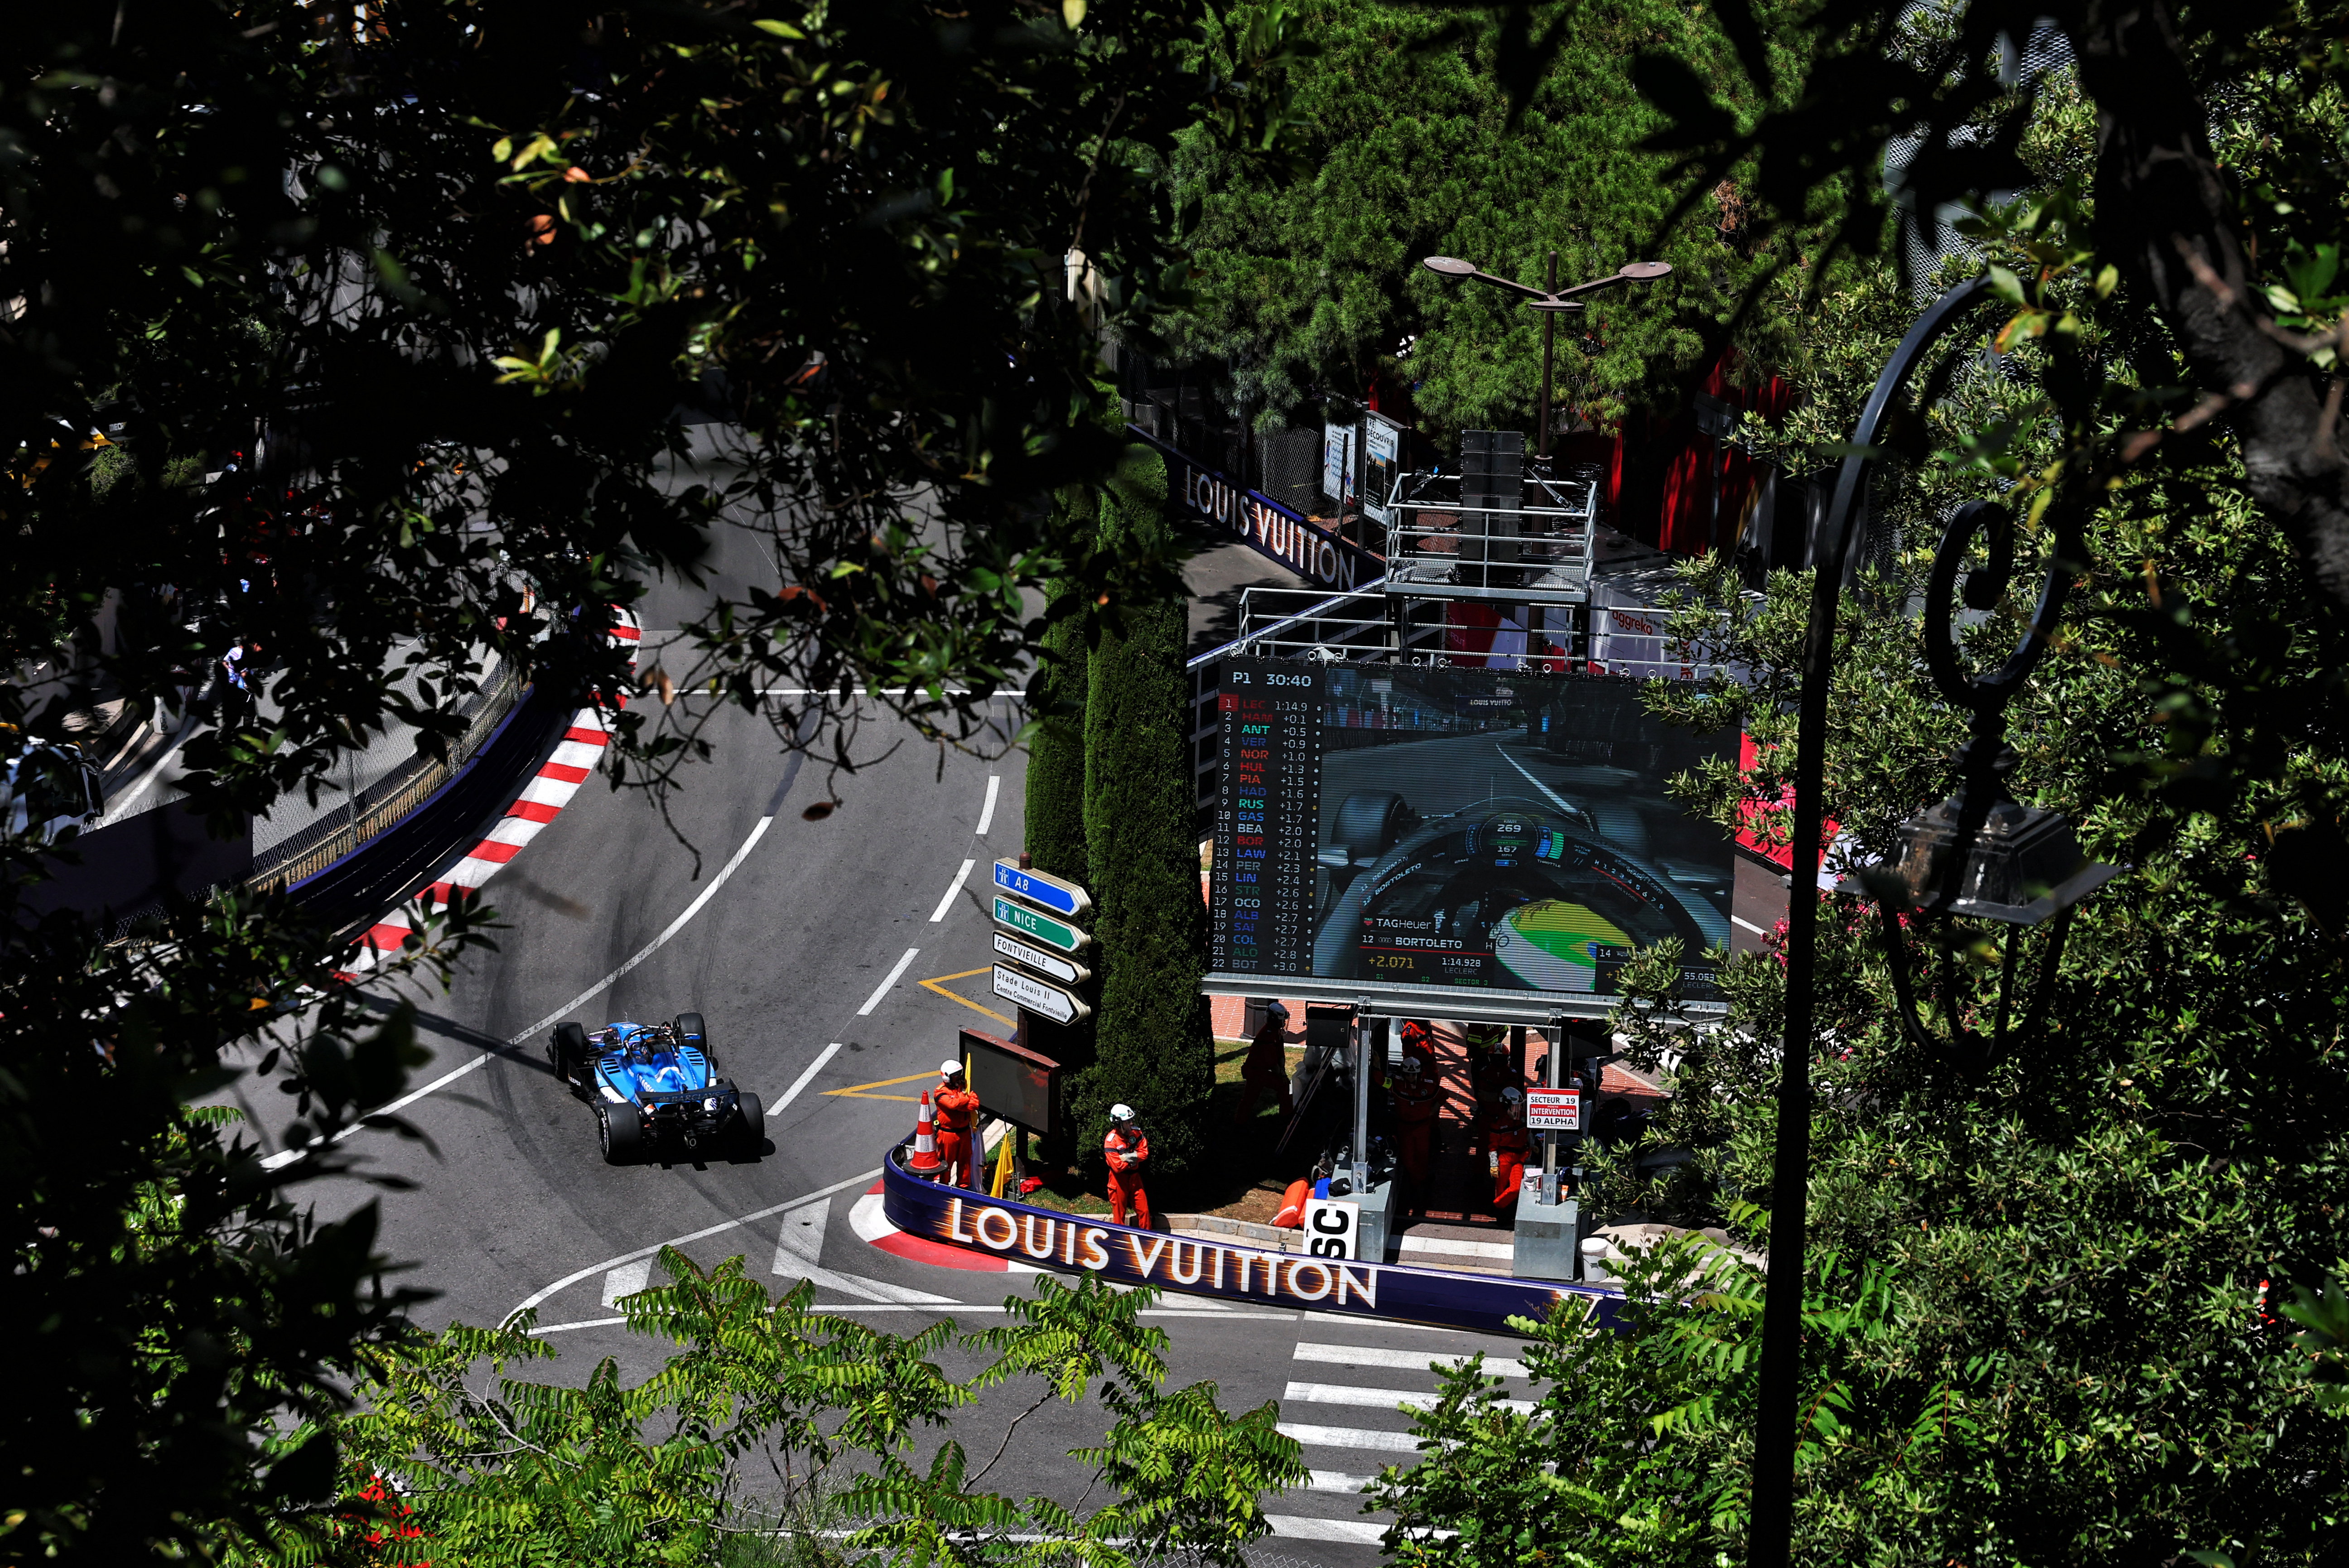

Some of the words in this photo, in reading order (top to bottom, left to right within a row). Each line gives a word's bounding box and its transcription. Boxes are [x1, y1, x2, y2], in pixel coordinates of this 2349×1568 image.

[1367, 428, 1394, 448] DÉCOUVRIR
[1187, 464, 1249, 536] LOUIS
[1256, 502, 1355, 591] VUITTON
[1612, 611, 1653, 635] aggreko
[1233, 672, 1251, 684] P1
[1267, 674, 1312, 687] 30:40
[1243, 700, 1265, 709] LEC
[1276, 701, 1307, 711] 1:14.9
[1243, 713, 1272, 722] HAM
[1284, 715, 1306, 724] +0.1
[1242, 725, 1270, 734] ANT
[1283, 728, 1306, 736] +0.5
[1242, 737, 1266, 746] VER
[1283, 740, 1305, 748] +0.9
[1224, 749, 1230, 757] 5
[1241, 749, 1269, 759] NOR
[1283, 752, 1305, 761] +1.0
[1240, 762, 1265, 772] HUL
[1282, 765, 1304, 773] +1.3
[1240, 774, 1260, 783] PIA
[1281, 777, 1303, 786] +1.5
[1222, 786, 1228, 794] 8
[1240, 786, 1266, 796] HAD
[1281, 789, 1303, 798] +1.6
[1239, 799, 1264, 808] RUS
[1280, 801, 1302, 811] +1.7
[1219, 811, 1230, 819] 10
[1239, 812, 1264, 821] GAS
[1280, 814, 1302, 823] +1.7
[1218, 823, 1229, 831] 11
[1238, 824, 1263, 833] BEA
[1279, 826, 1302, 835] +2.0
[1497, 824, 1521, 833] 269
[1238, 836, 1263, 845] BOR
[1279, 839, 1301, 848] +2.0
[1217, 848, 1229, 856] 13
[1237, 849, 1266, 858] LAW
[1278, 851, 1300, 860] +2.1
[1216, 860, 1228, 868] 14
[1236, 861, 1260, 870] PER
[1278, 864, 1299, 873] +2.3
[1373, 856, 1409, 882] BEARMAN
[1537, 859, 1561, 868] THROTTLE
[1015, 876, 1029, 891] A8
[1216, 873, 1227, 881] 15
[1236, 873, 1256, 882] LIN
[1277, 876, 1299, 884] +2.4
[1363, 896, 1372, 906] 12
[1375, 863, 1422, 896] BORTOLETO
[1215, 885, 1227, 893] 16
[1235, 886, 1260, 895] STR
[1277, 888, 1299, 897] +2.6
[1235, 898, 1260, 907] OCO
[1276, 901, 1298, 910] +2.6
[1014, 911, 1037, 931] NICE
[1215, 909, 1226, 918] 18
[1234, 911, 1258, 920] ALB
[1276, 913, 1297, 922] +2.7
[1234, 923, 1254, 931] SAI
[1275, 925, 1297, 934] +2.7
[1234, 935, 1256, 944] COL
[1275, 937, 1297, 946] +2.7
[1362, 935, 1374, 943] 12
[1395, 937, 1462, 949] BORTOLETO
[998, 939, 1047, 967] FONTVIEILLE
[1233, 948, 1258, 957] ALO
[1274, 950, 1296, 959] +2.8
[1600, 949, 1611, 957] 14
[1233, 960, 1258, 969] BOT
[1273, 962, 1296, 971] +3.0
[1369, 955, 1414, 969] +2.071
[1442, 957, 1481, 967] 1:14.928
[1445, 967, 1478, 975] LECLERC
[997, 971, 1018, 987] Stade
[1022, 980, 1041, 996] Louis
[1044, 990, 1050, 1000] II
[997, 984, 1013, 998] Centre
[1013, 989, 1041, 1008] Commercial
[1042, 1003, 1067, 1019] Fontvieille
[1309, 1208, 1349, 1259] SC
[952, 1197, 1109, 1271] LOUIS
[1130, 1233, 1378, 1310] VUITTON
